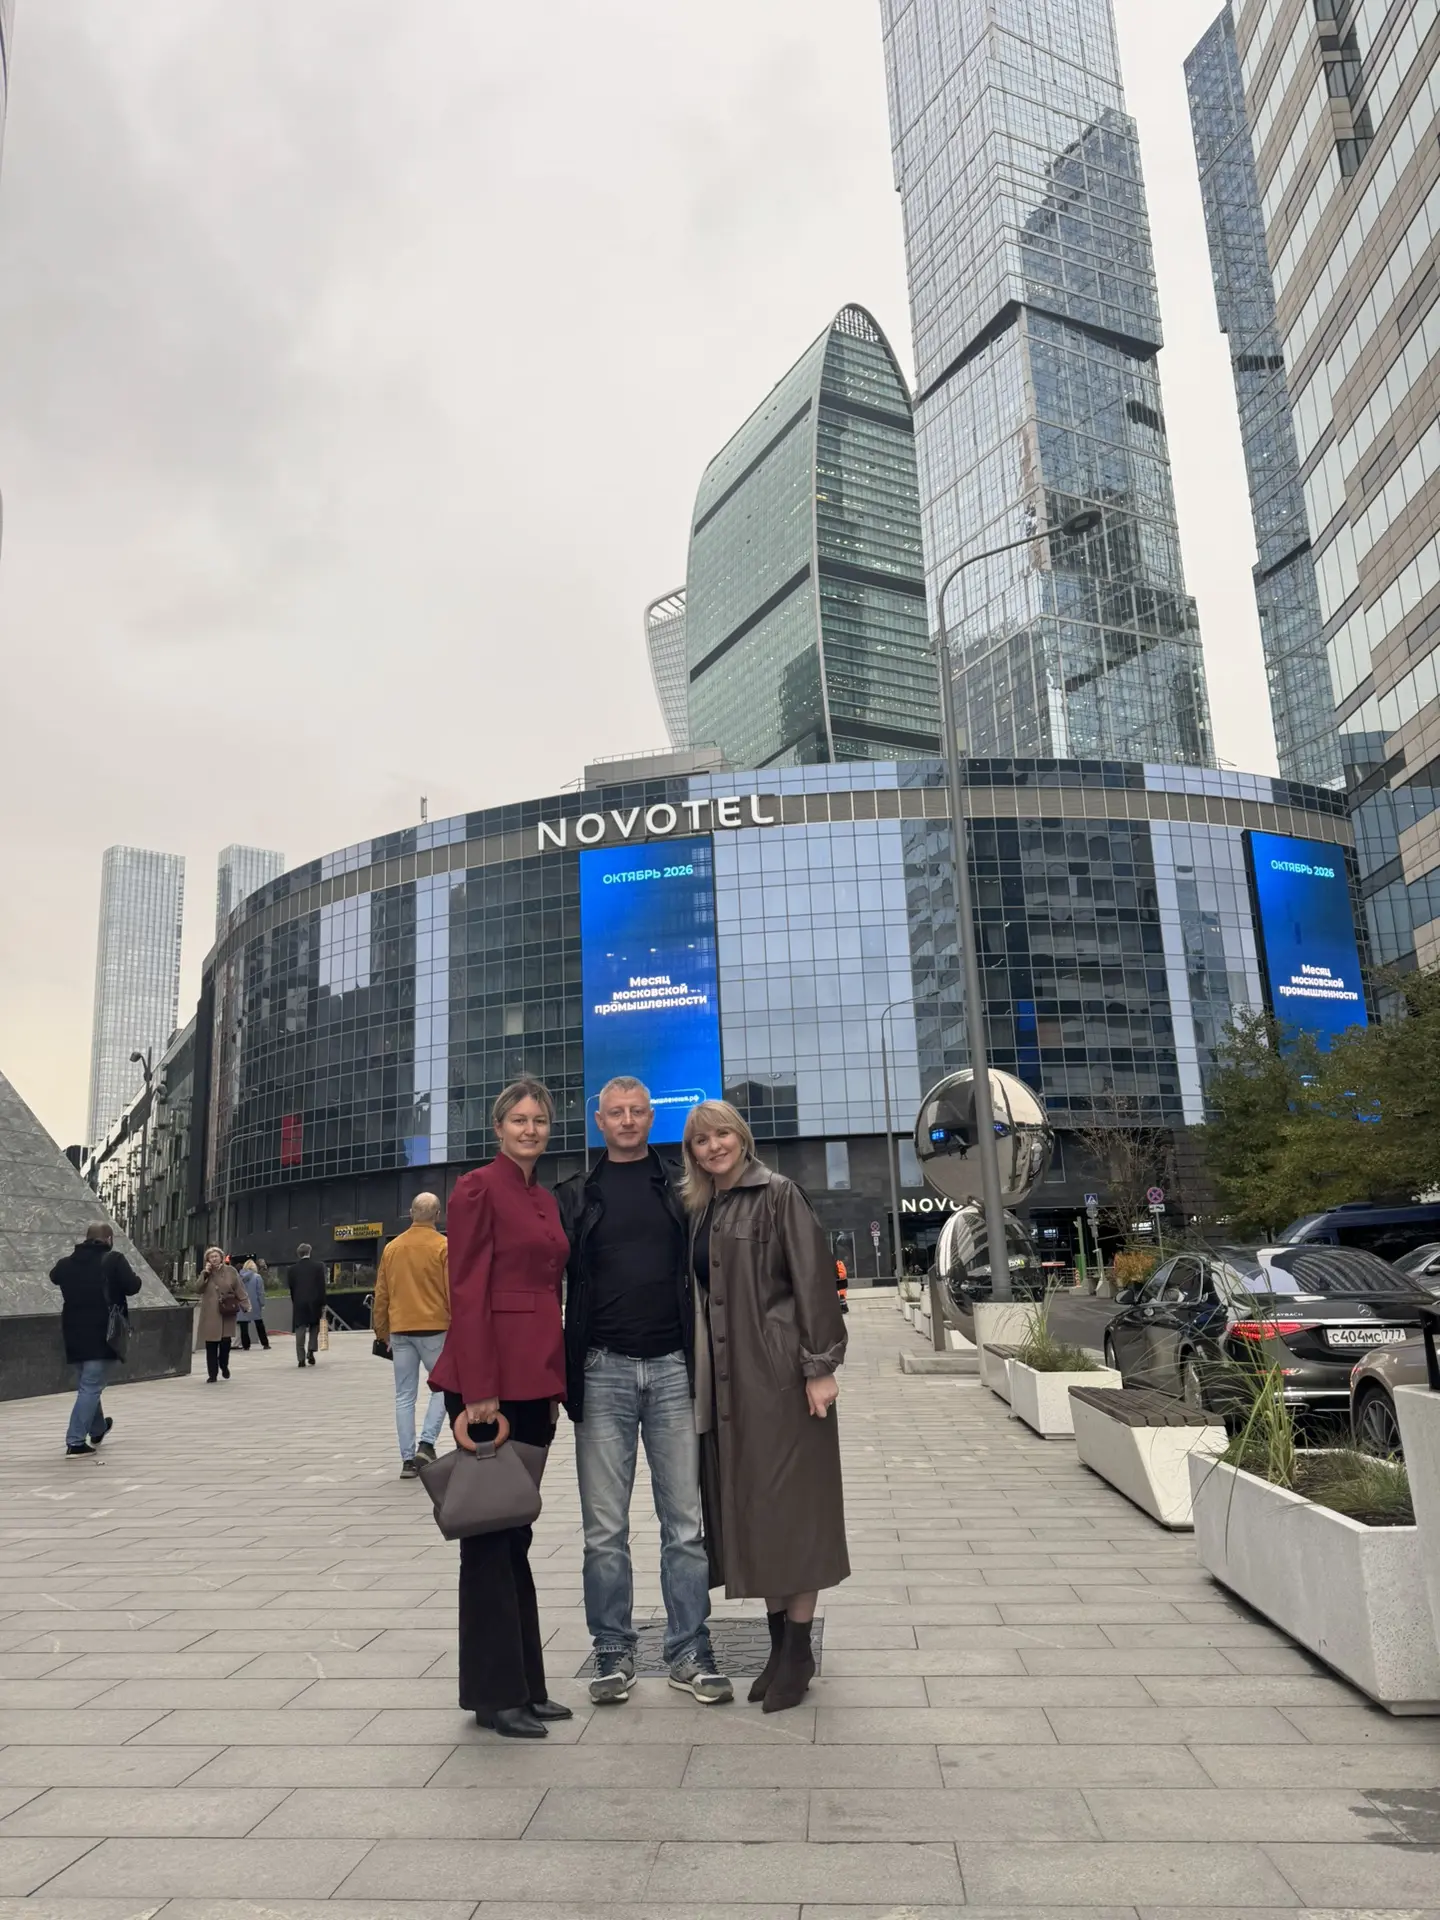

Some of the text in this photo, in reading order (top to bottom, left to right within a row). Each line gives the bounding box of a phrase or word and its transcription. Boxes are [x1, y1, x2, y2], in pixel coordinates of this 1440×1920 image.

[538, 794, 774, 850] NOVOTEL
[602, 864, 694, 884] ОКТЯБРЬ 2026
[1270, 859, 1335, 878] ОКТЯБРЬ 2026
[1301, 963, 1332, 978] Месяц
[629, 975, 671, 988] Месяц
[1290, 975, 1344, 989] московской
[612, 983, 688, 1001] московской
[1279, 985, 1359, 1001] промышленности
[594, 995, 708, 1016] промышленности
